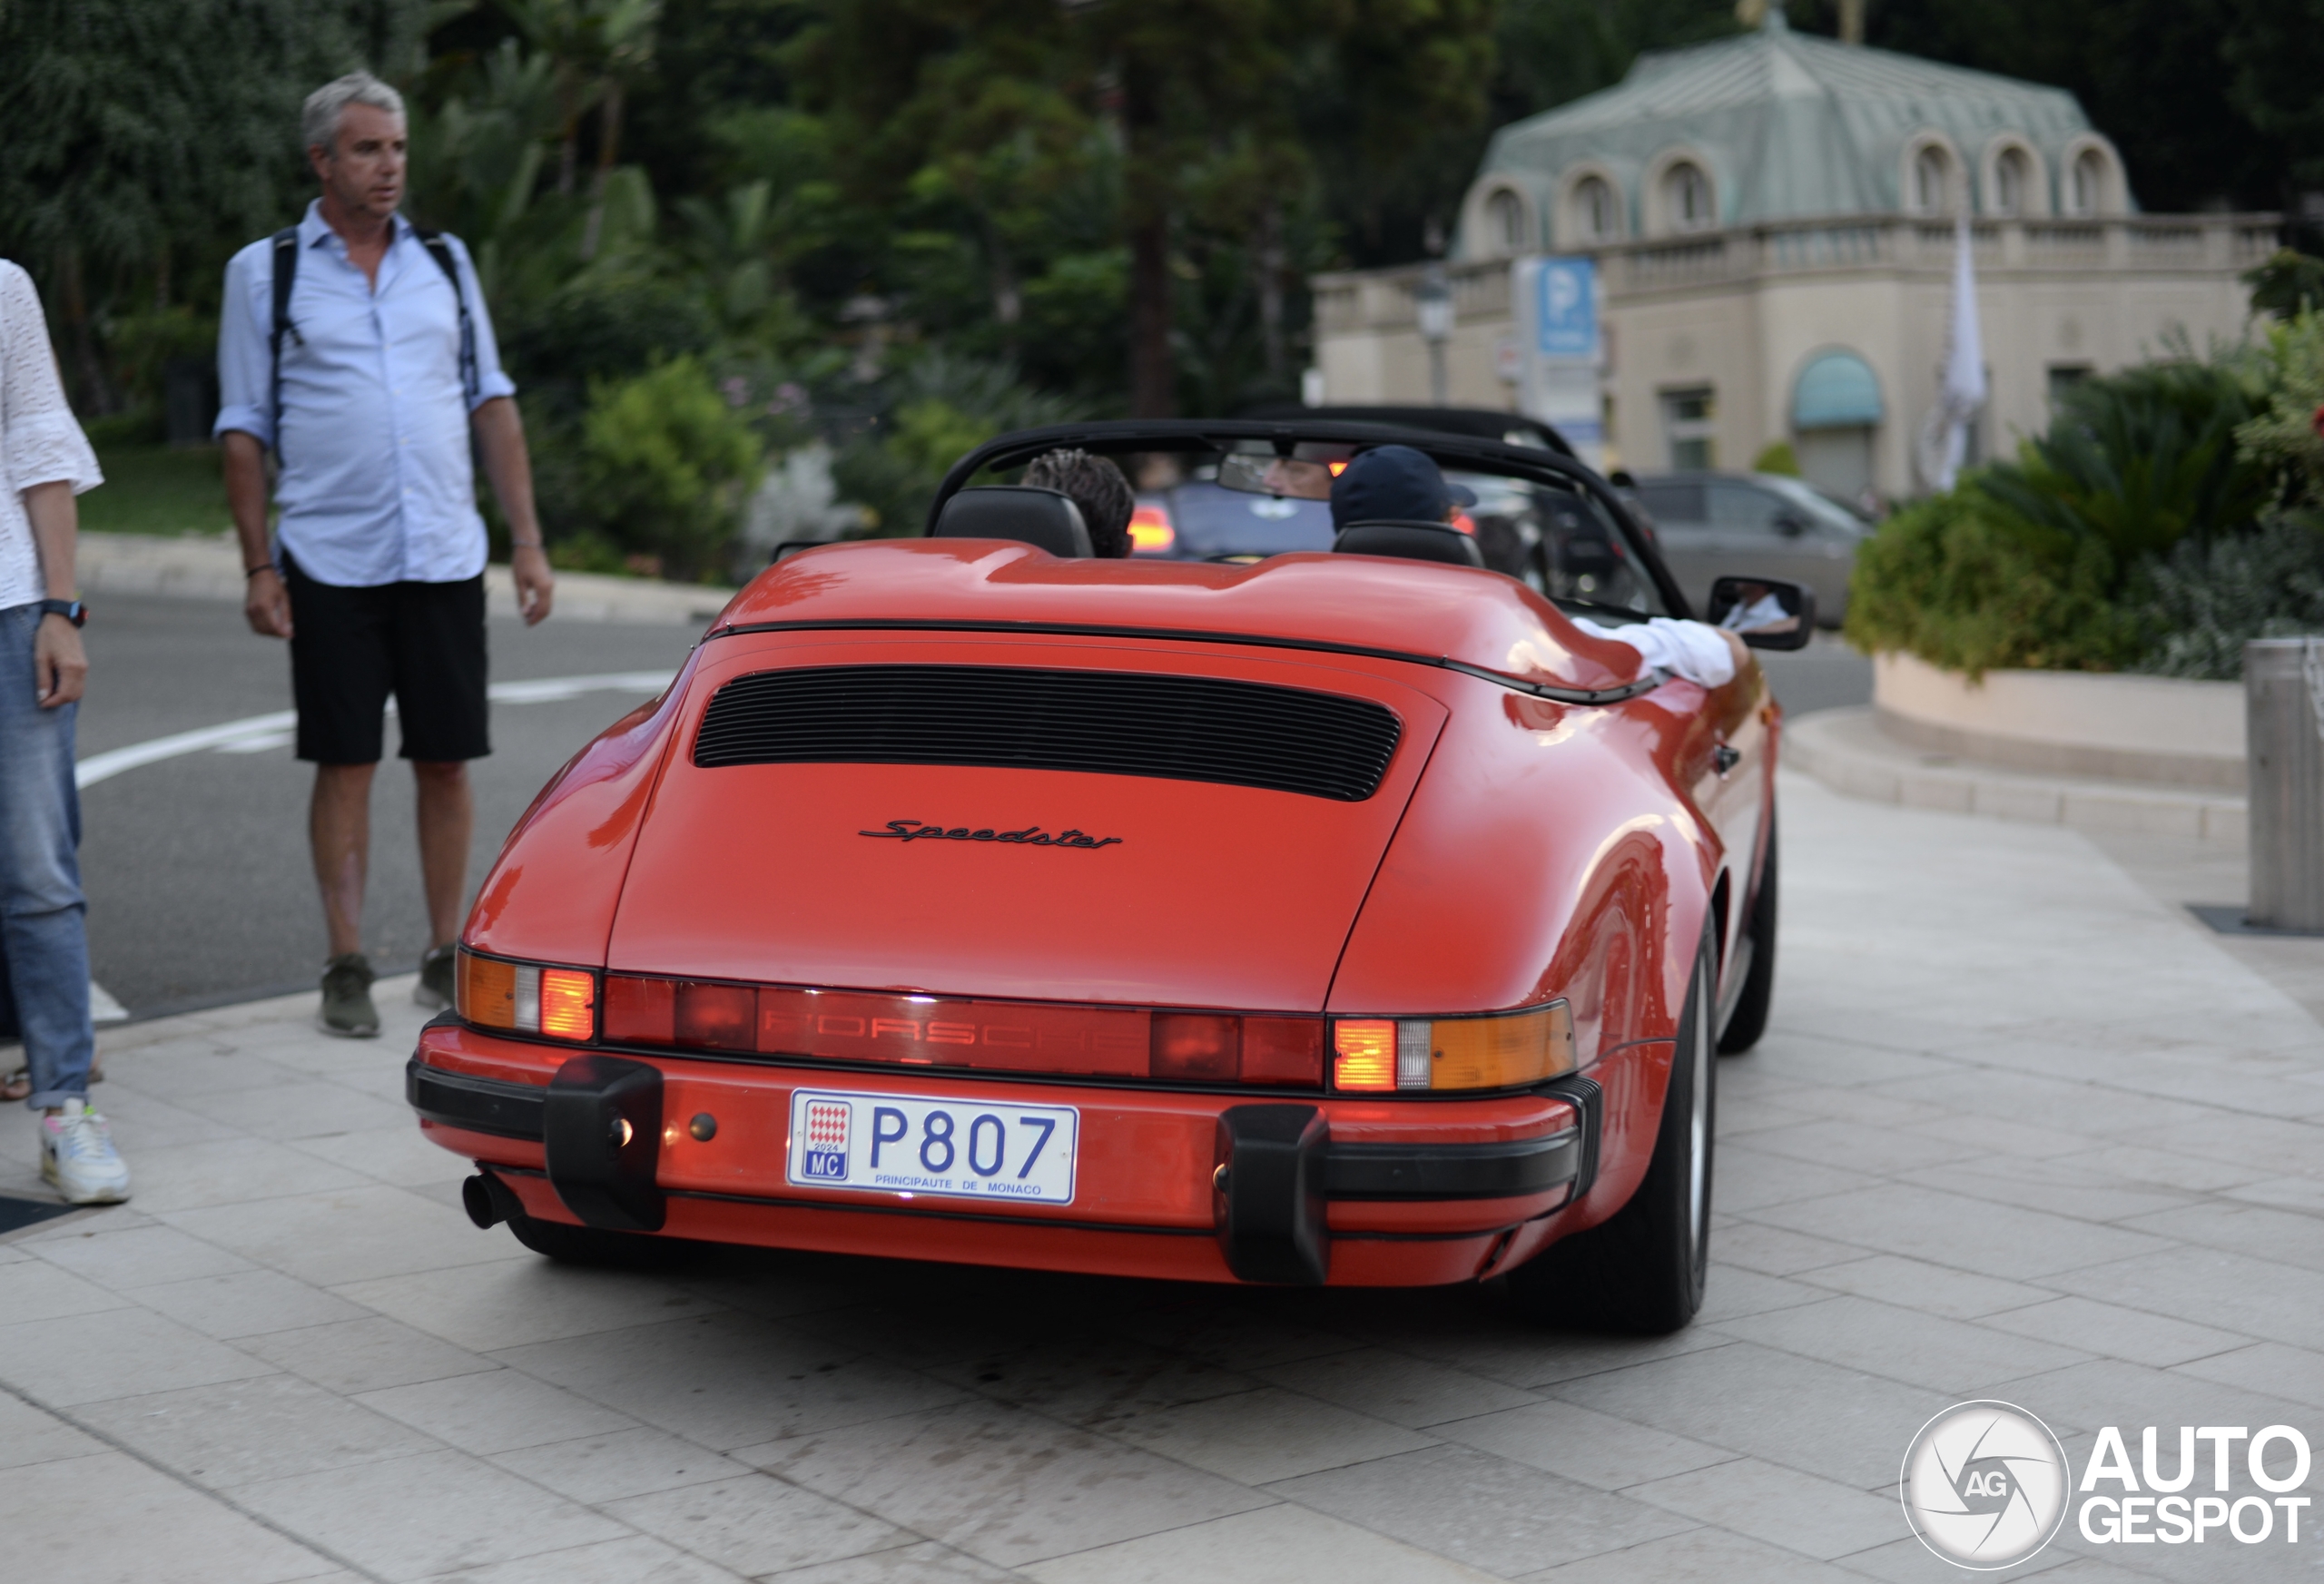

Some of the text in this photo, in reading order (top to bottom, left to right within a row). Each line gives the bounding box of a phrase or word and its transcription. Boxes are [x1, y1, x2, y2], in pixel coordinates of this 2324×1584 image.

[1547, 267, 1581, 325] P
[858, 820, 1124, 849] Speedster
[764, 1009, 1143, 1052] PORSCHE
[813, 1143, 839, 1153] 2024
[870, 1106, 1056, 1179] P807
[811, 1153, 839, 1176] MC
[874, 1174, 1041, 1195] PRINCIPAUTE DE MONACO
